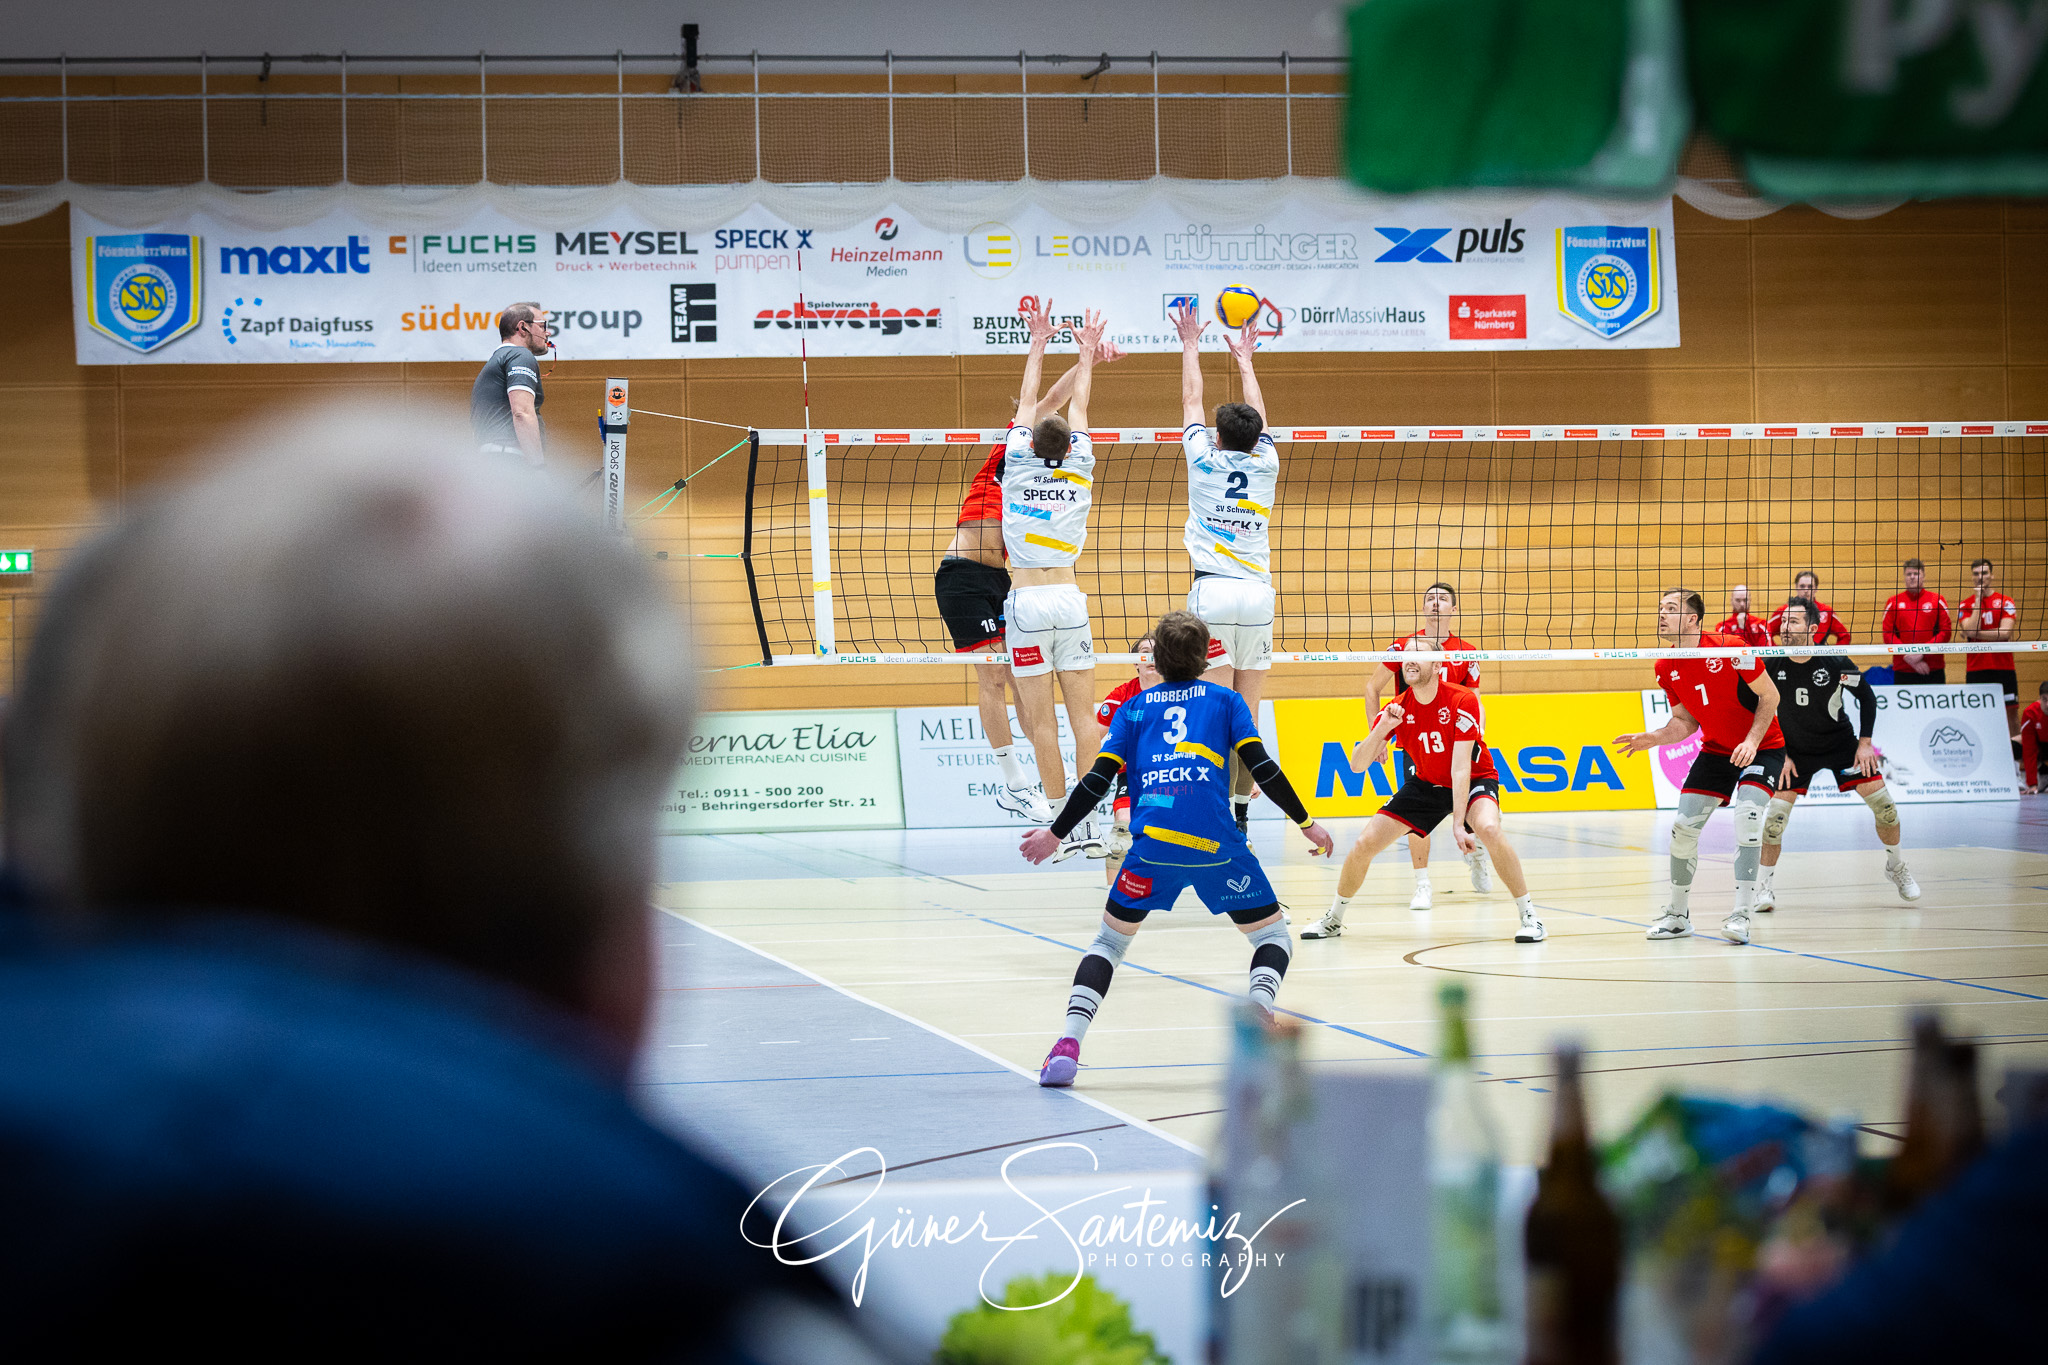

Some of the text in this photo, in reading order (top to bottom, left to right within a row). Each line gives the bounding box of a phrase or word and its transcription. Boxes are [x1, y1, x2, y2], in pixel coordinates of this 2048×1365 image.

[423, 235, 536, 254] FUCHS
[555, 231, 698, 256] MEYSEL
[715, 229, 789, 250] SPECK
[1036, 235, 1152, 257] LEONDA
[1455, 218, 1526, 262] puls
[220, 235, 370, 275] maxit
[830, 247, 943, 263] Heinzelmann
[423, 259, 537, 273] Ideen umsetzen
[555, 261, 593, 272] Druck
[610, 260, 697, 271] Werbetechnik
[715, 254, 790, 274] pumpen
[866, 265, 908, 277] Medien
[1067, 262, 1127, 272] ENERGIE
[673, 287, 687, 339] TEAM
[807, 301, 869, 309] Spielwaren
[401, 303, 642, 337] südw group
[1301, 307, 1425, 324] DörrMassivHaus
[1474, 308, 1517, 320] Sparkasse
[241, 316, 373, 340] Zapf Daigfuss
[973, 316, 1084, 330] BAUMLER
[1474, 319, 1515, 332] Nürnberg
[986, 331, 1072, 344] SERVES
[1111, 334, 1218, 344] FÜRST & PANER
[1360, 329, 1380, 337] HAUS
[1382, 329, 1399, 337] ZUM
[610, 440, 620, 469] SPORT
[1042, 476, 1068, 484] Schwaig
[1225, 471, 1248, 500] 2
[1023, 489, 1065, 501] SPECK
[1023, 502, 1066, 515] pumpen
[1226, 505, 1256, 516] Schwaig
[981, 619, 996, 633] 16
[1982, 611, 1993, 626] 10
[1145, 685, 1206, 704] DOBBERTIN
[1694, 683, 1709, 706] 7
[1795, 687, 1810, 706] 6
[1897, 689, 1996, 710] Smarten
[1162, 706, 1188, 745] 3
[687, 723, 876, 753] erna Elia
[1418, 731, 1445, 754] 13
[680, 752, 868, 766] MEDITERRANEAN CUISINE
[1152, 751, 1196, 763] SV Schwaig
[1666, 743, 1694, 762] Mehr
[1142, 767, 1192, 788] SPECK
[678, 789, 709, 799] Tel.:
[714, 788, 750, 798] 0911
[765, 786, 792, 797] 500
[797, 786, 824, 796] 200
[1118, 786, 1127, 794] 2
[702, 799, 824, 812] Behringersdorfer
[829, 798, 854, 808] Str.
[860, 798, 876, 807] 21
